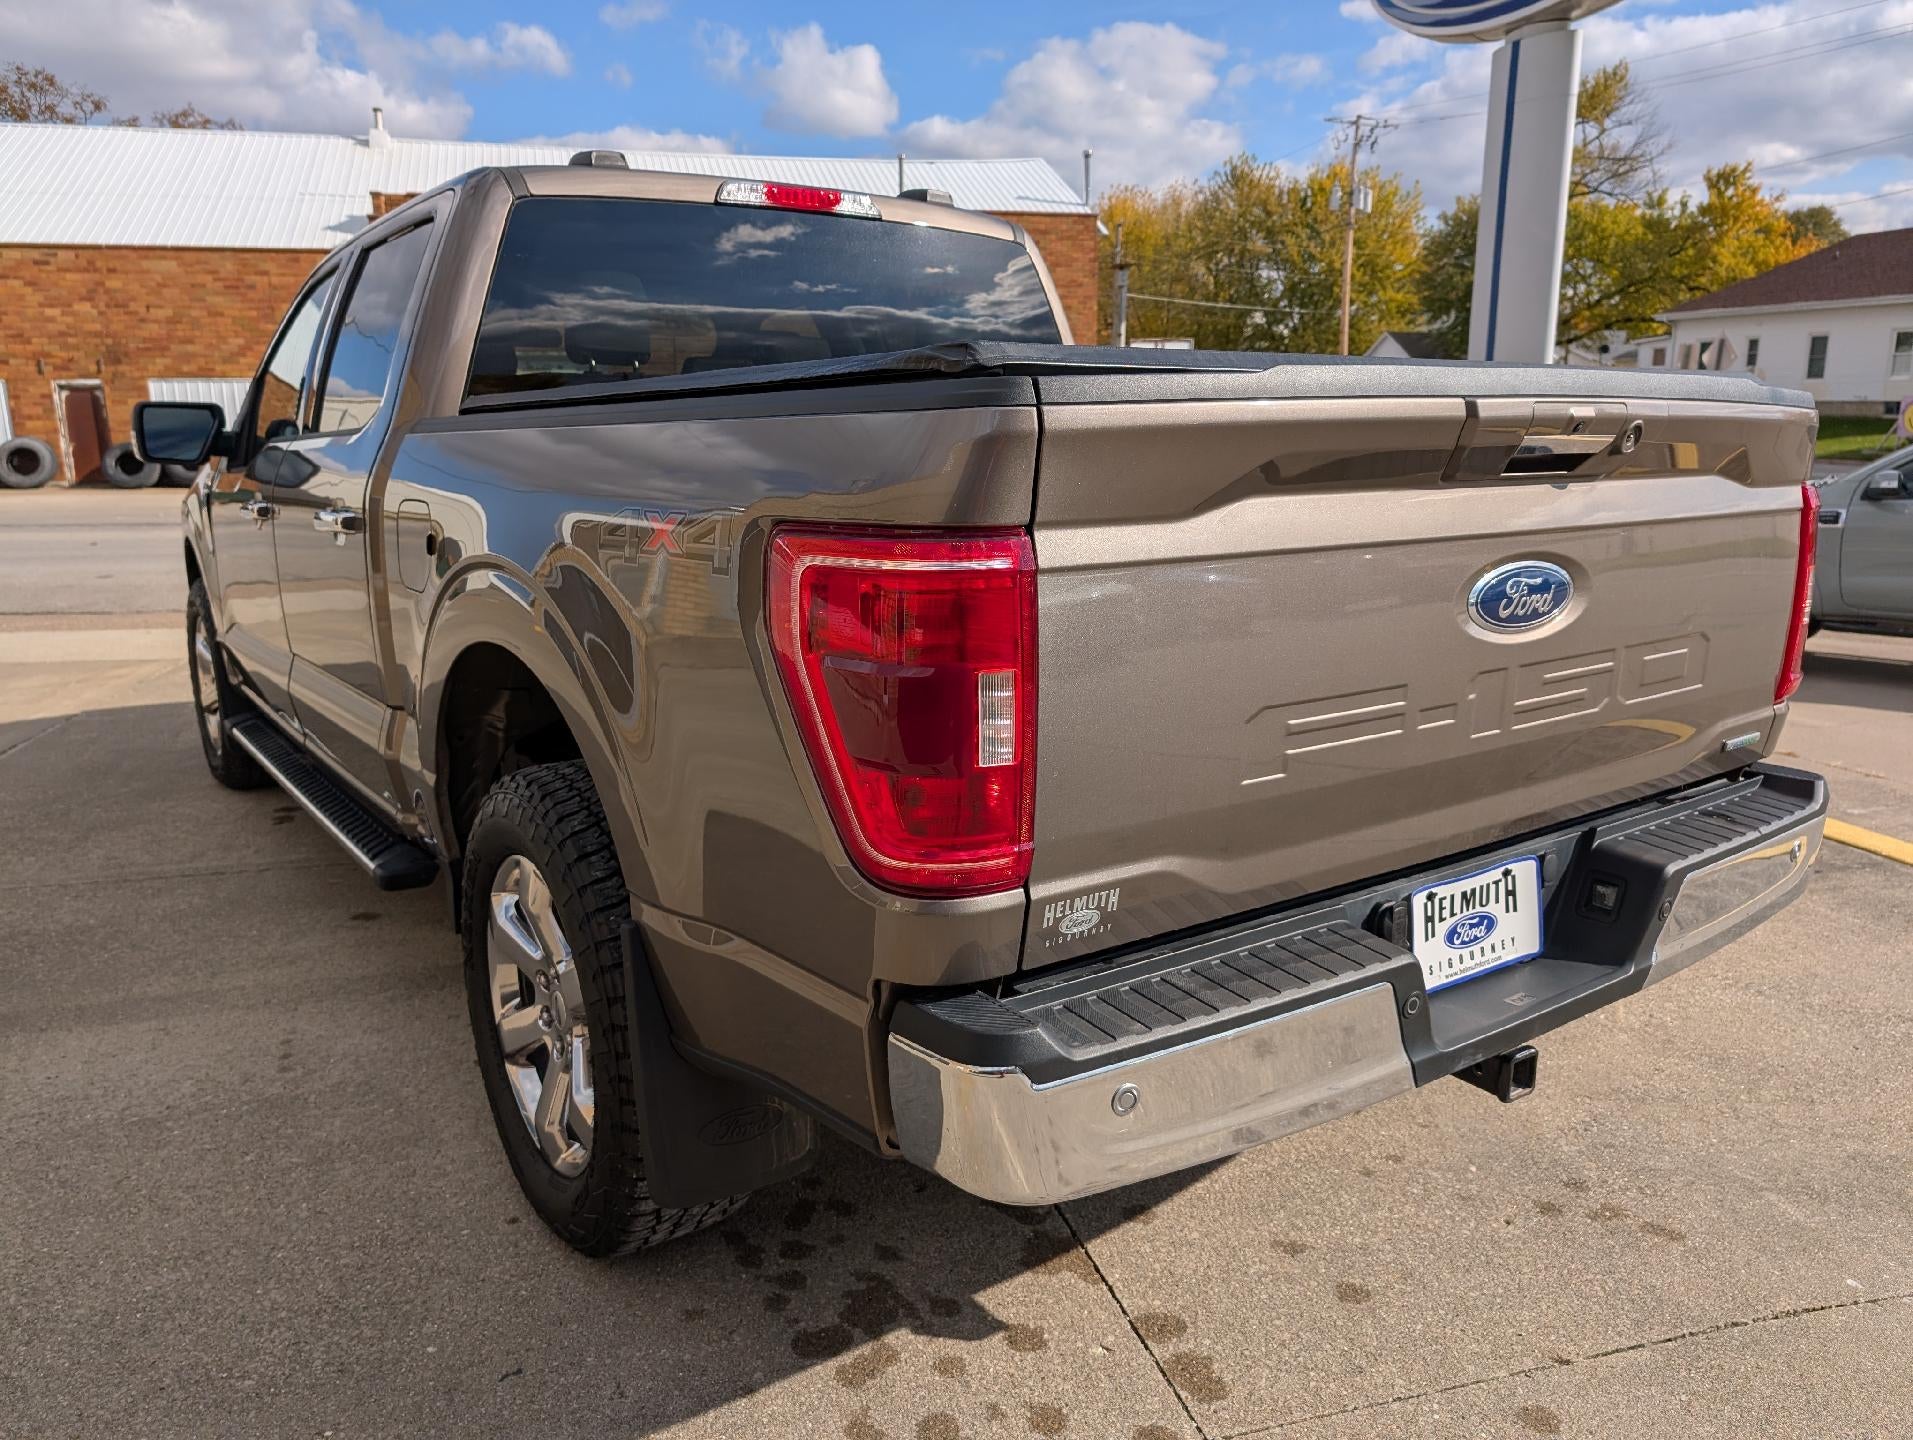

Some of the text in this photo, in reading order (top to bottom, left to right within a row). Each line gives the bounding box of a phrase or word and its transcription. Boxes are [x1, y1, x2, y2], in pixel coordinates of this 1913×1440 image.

[1240, 631, 1710, 786] F-150
[1042, 887, 1121, 929] HELMUTH
[1423, 873, 1518, 943] HELMUTH
[1428, 936, 1517, 976] SIGOURNEY
[1444, 955, 1503, 980] www.helmuthford.com
